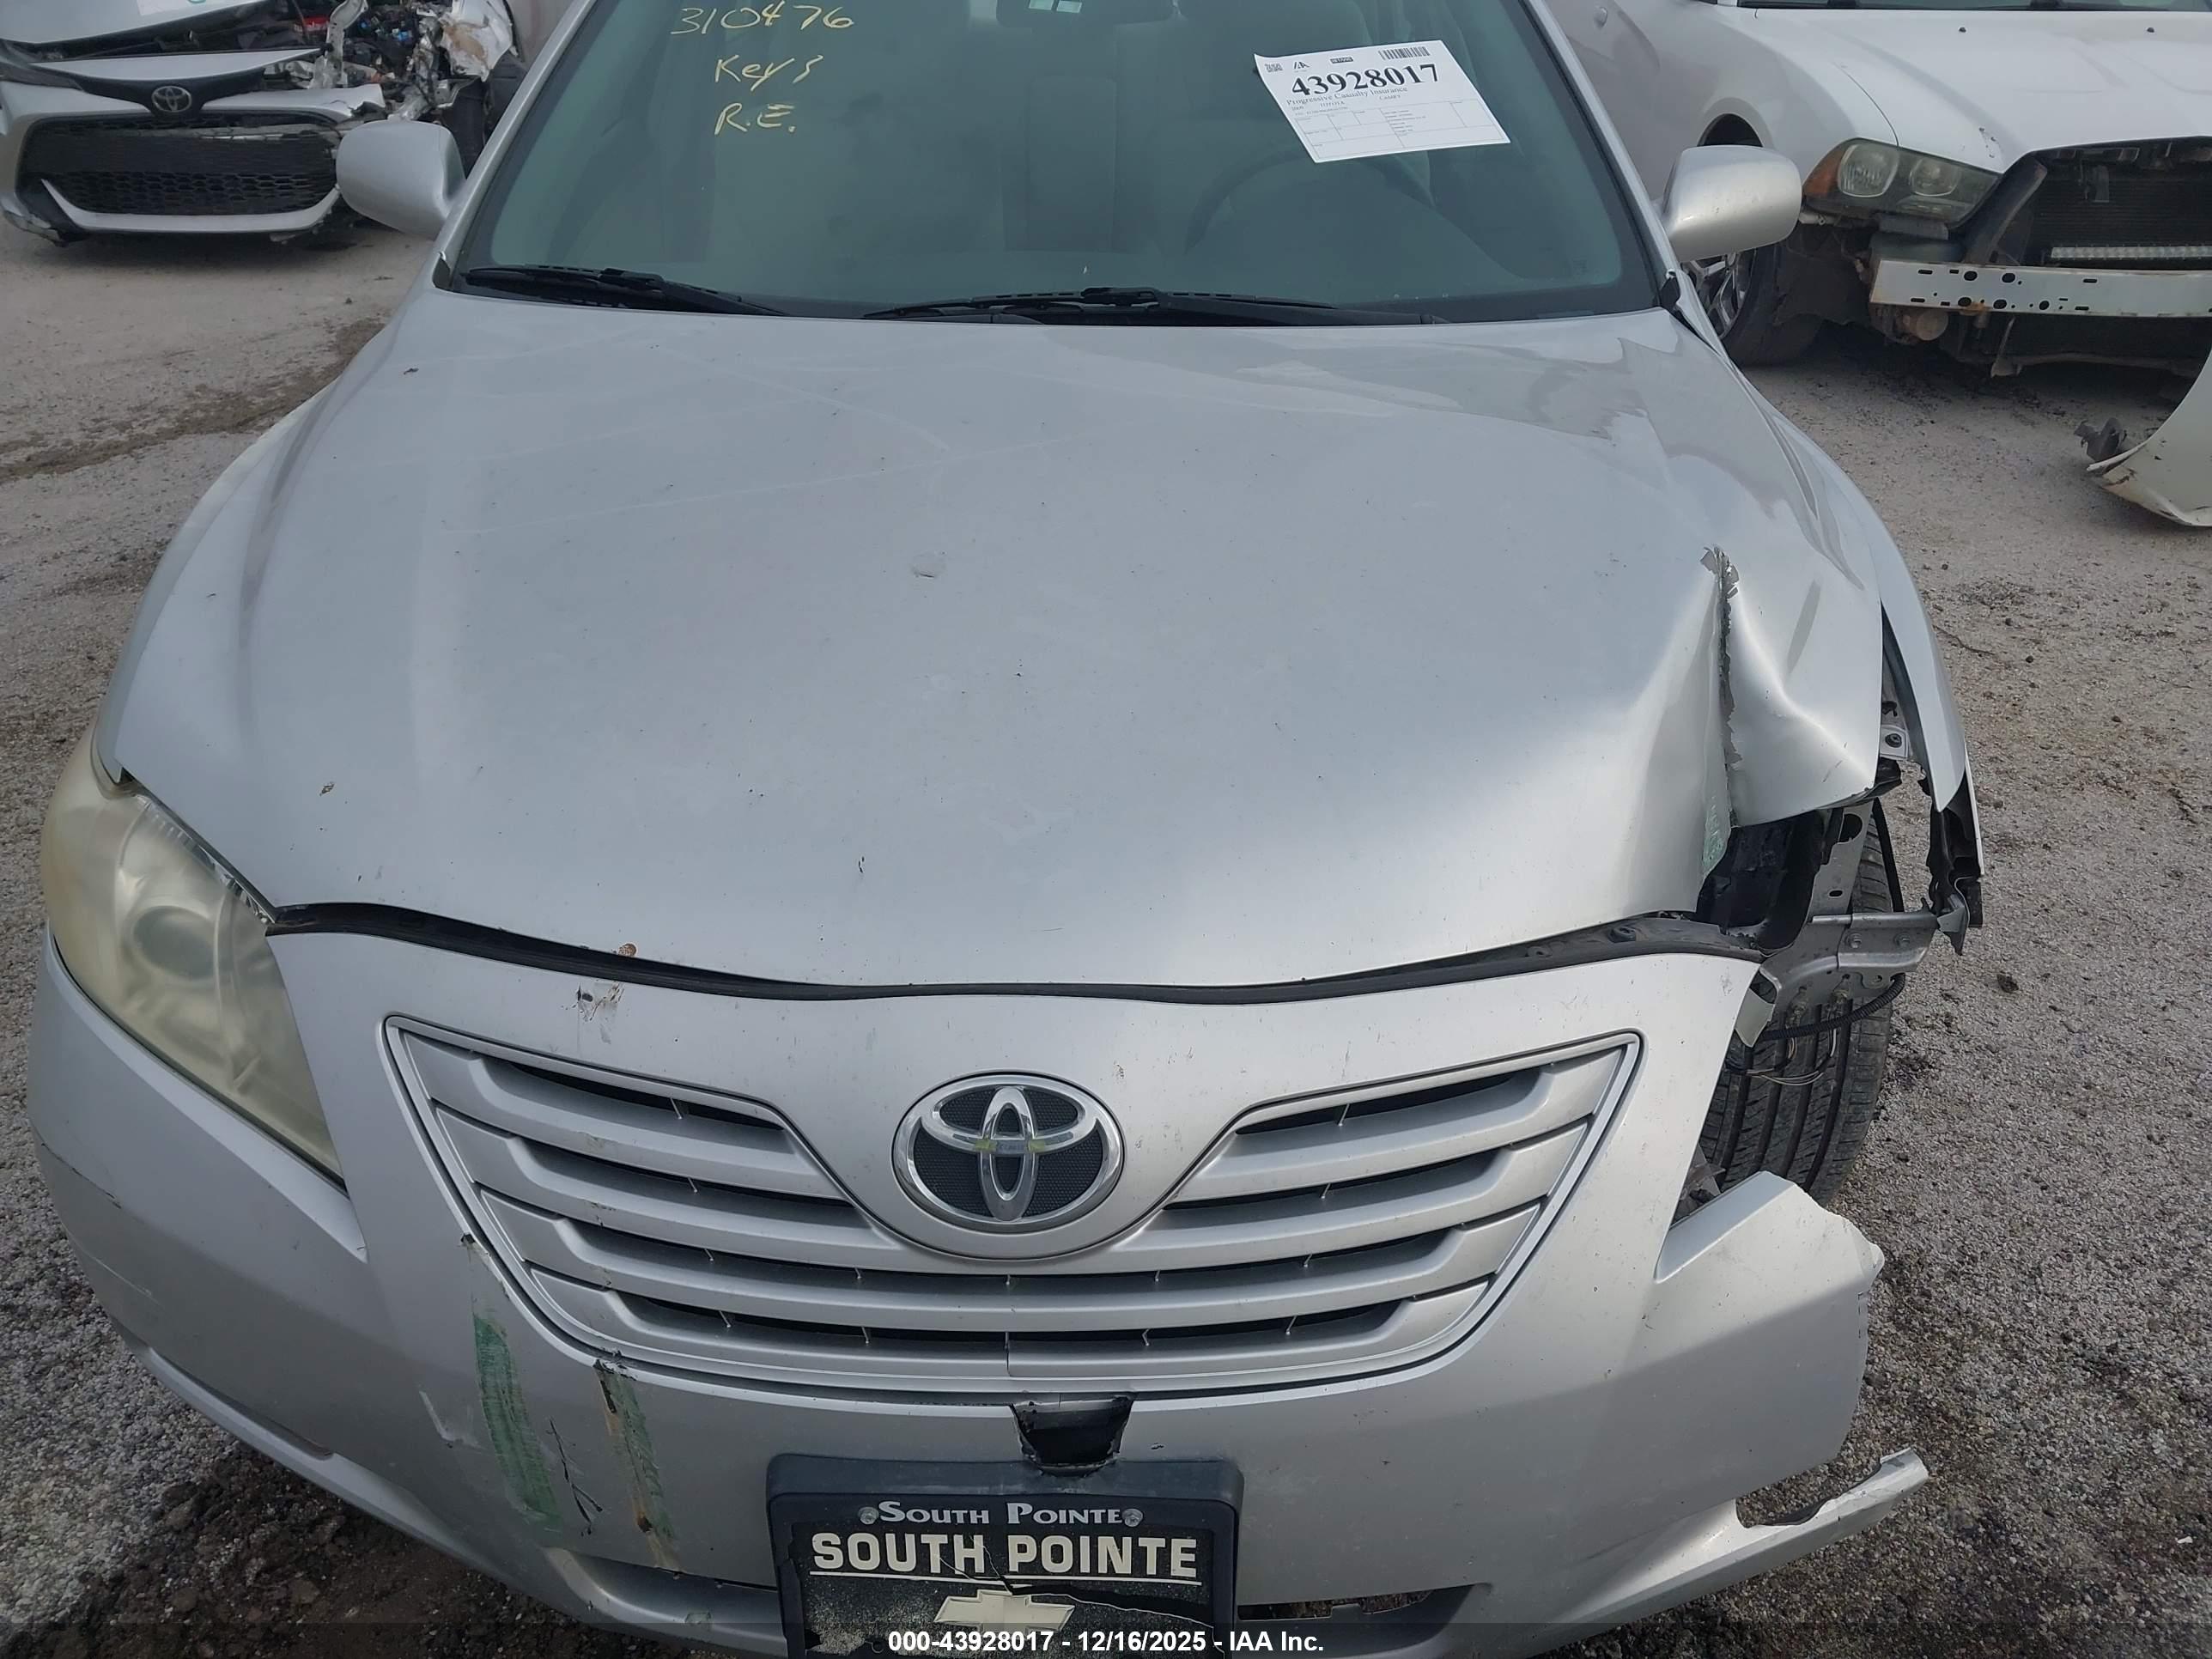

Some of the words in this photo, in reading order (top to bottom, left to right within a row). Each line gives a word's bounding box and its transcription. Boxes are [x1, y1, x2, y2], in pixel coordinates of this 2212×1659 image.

[1286, 94, 1333, 106] Progressive
[1334, 88, 1370, 100] Casualty
[1370, 86, 1408, 96] Insurance
[1291, 63, 1439, 97] 43928017
[812, 1532, 985, 1575] SOUTH
[1008, 1534, 1198, 1578] POINTE
